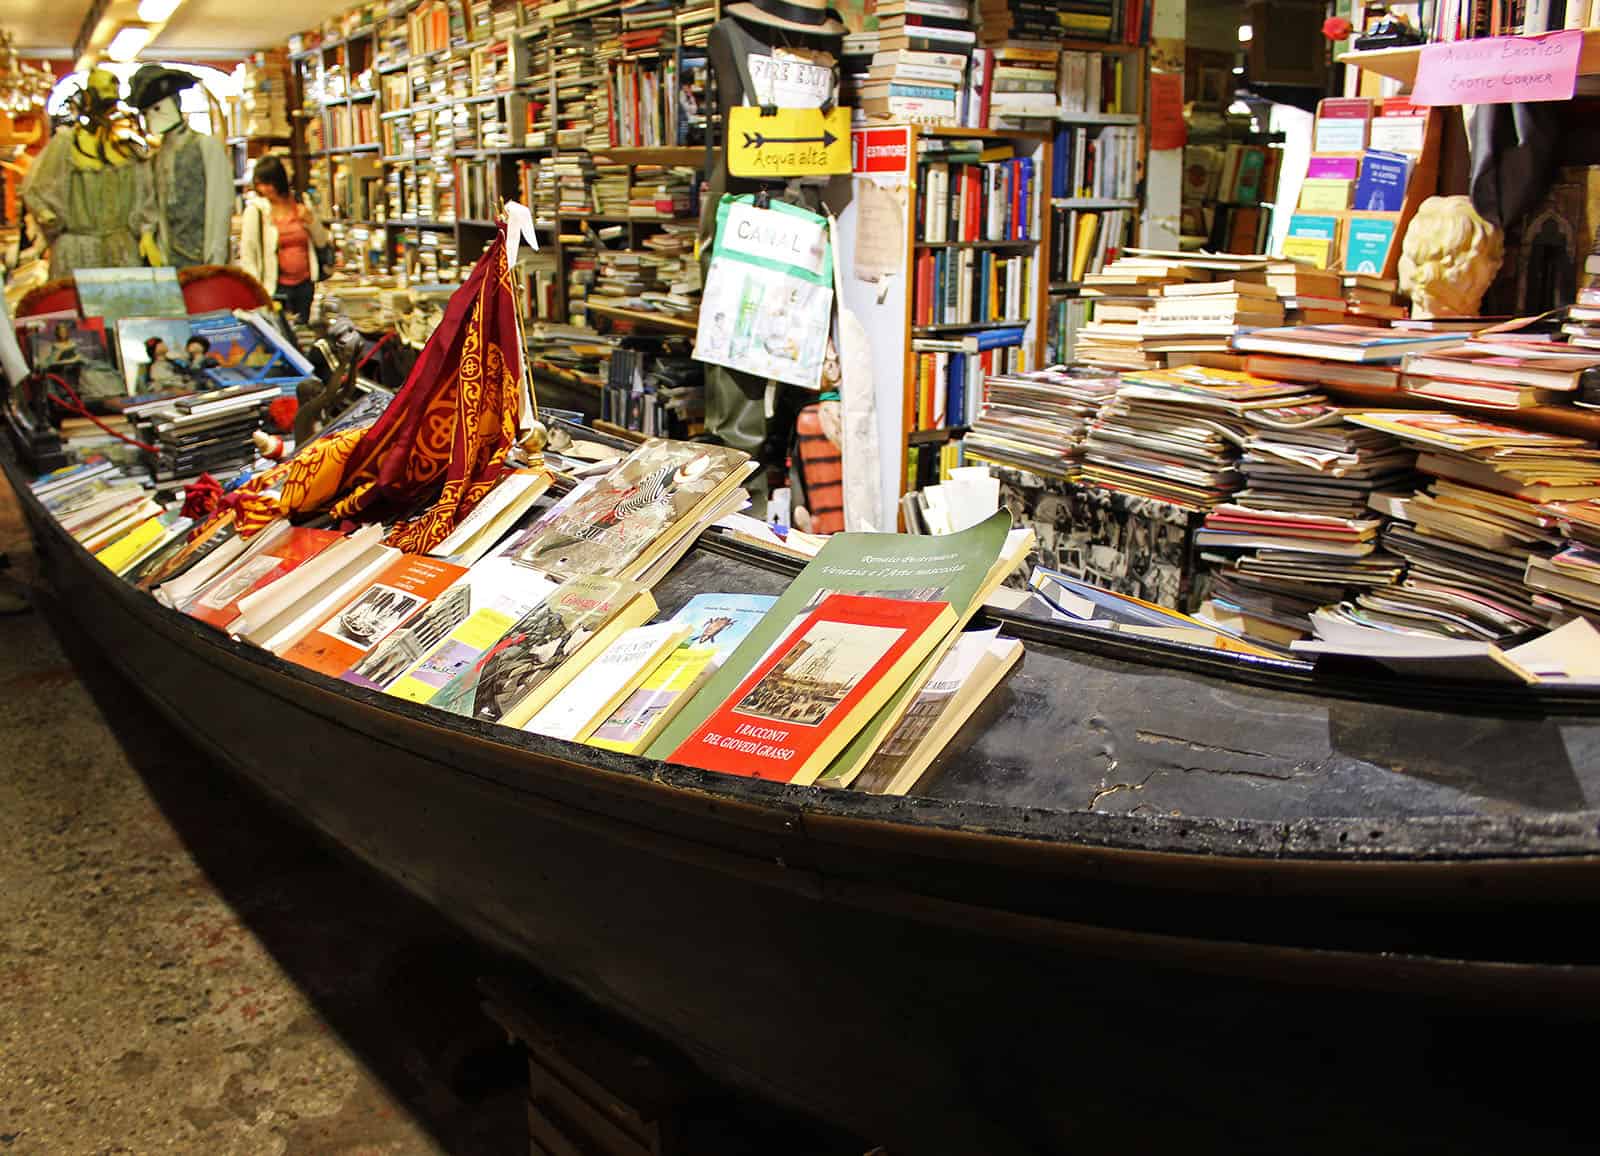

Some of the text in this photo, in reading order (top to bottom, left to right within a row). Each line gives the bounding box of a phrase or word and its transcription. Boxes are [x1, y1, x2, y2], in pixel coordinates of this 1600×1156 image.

[1502, 70, 1553, 87] CORNER
[753, 146, 828, 171] Acqua alta
[737, 219, 801, 253] CANAL
[735, 723, 789, 742] I RACCONTI
[703, 732, 722, 746] DEL
[757, 744, 796, 761] GRASSO
